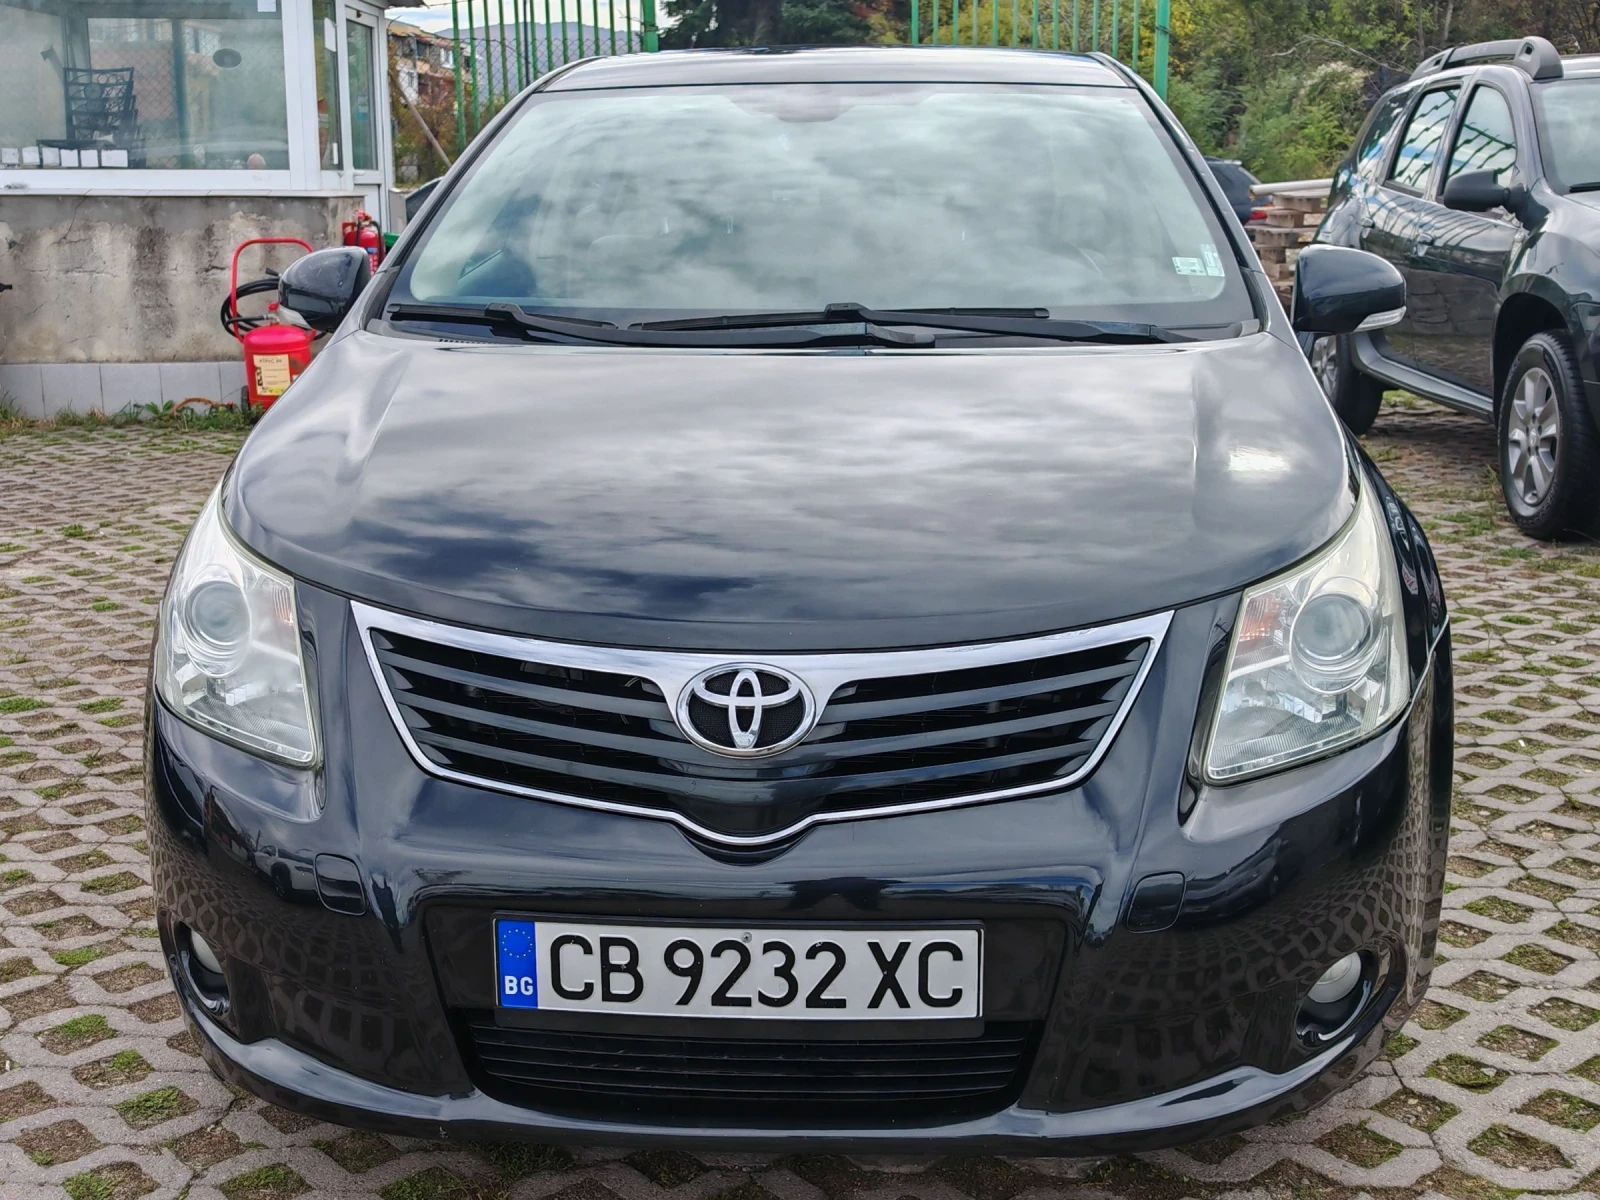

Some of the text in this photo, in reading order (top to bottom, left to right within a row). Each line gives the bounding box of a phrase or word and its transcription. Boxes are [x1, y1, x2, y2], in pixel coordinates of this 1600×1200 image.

[504, 975, 534, 996] BG
[549, 934, 964, 1009] CB 9232 XC
